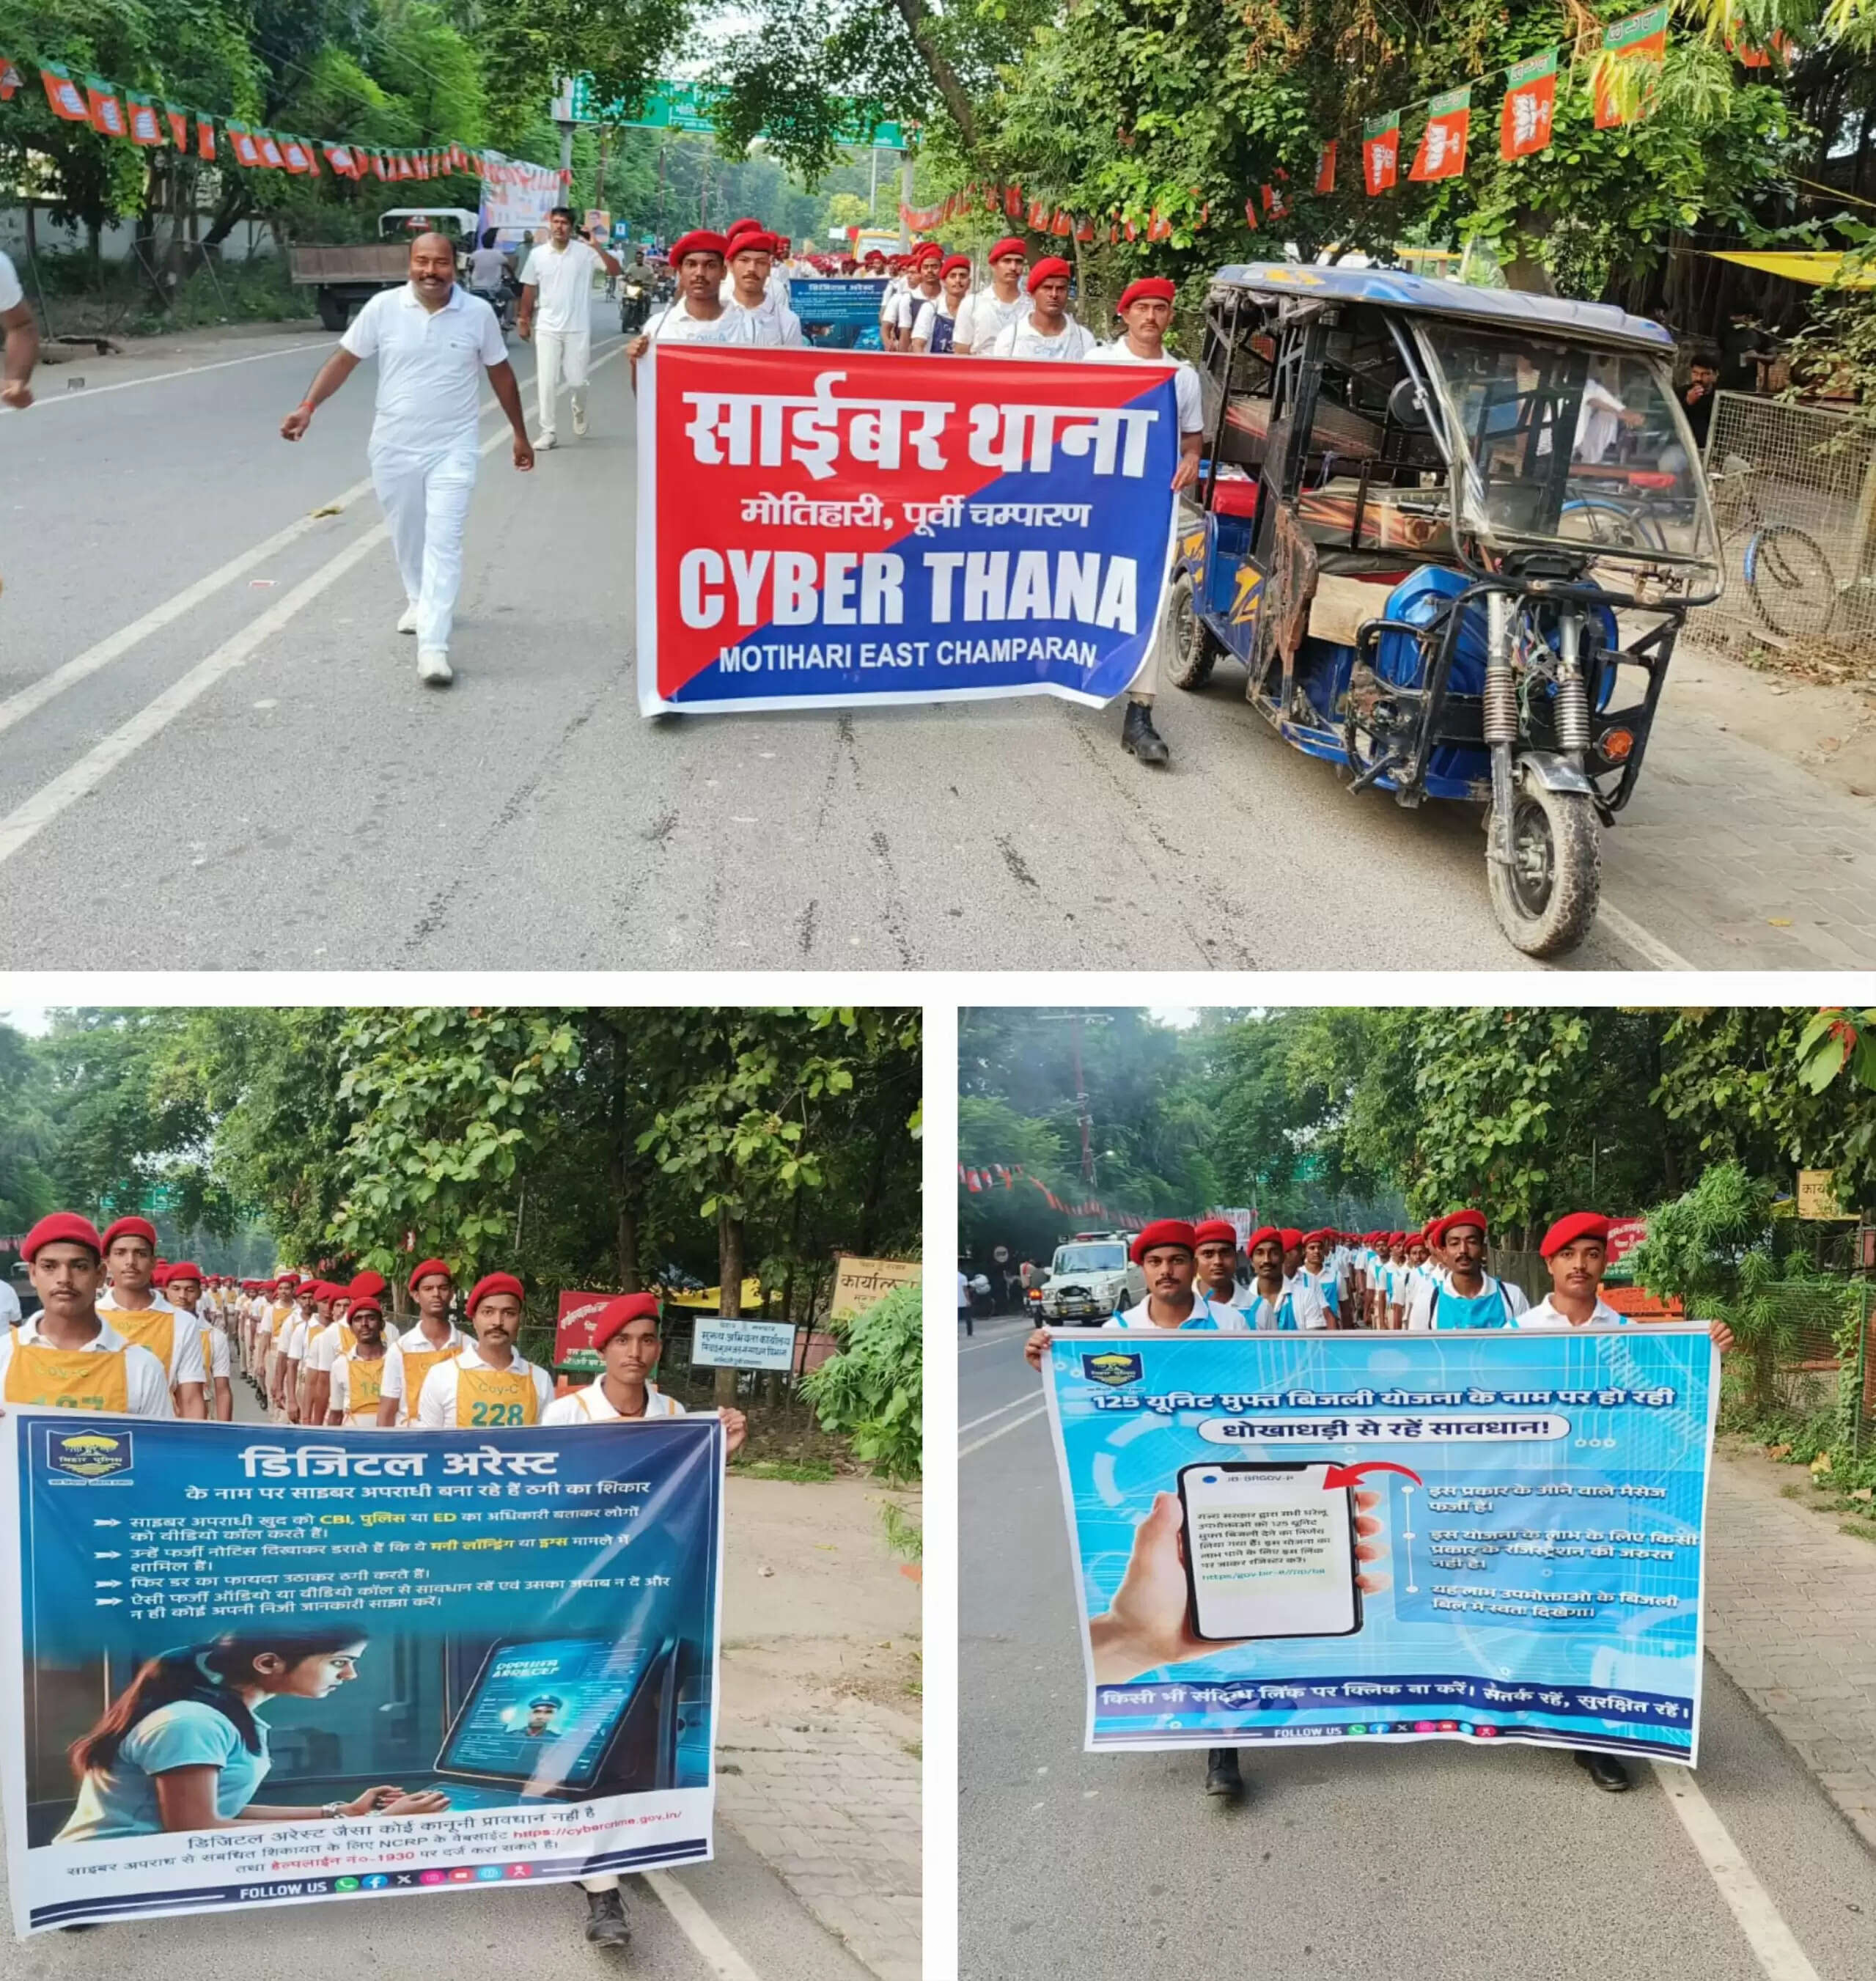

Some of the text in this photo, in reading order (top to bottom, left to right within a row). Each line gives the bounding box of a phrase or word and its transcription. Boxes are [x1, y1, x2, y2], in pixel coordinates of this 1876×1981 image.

[683, 371, 1158, 479] साईबर थाना
[741, 492, 1092, 537] मोतिहारी, पूर्वी चम्पारण
[679, 548, 1137, 635] CYBER THANA
[719, 637, 1096, 672] MOTIHARI EAST CHAMPARAN
[841, 1272, 919, 1290] कार्याल
[1093, 1387, 1674, 1413] 125 यूनिट मुफ्त बिजली योजना के नाम पर हो रही
[472, 1401, 523, 1427] 228
[1223, 1419, 1549, 1442] धोखाधड़ी से रहें सावधान!
[238, 1445, 559, 1478] डिजिटल अरेस्ट
[185, 1485, 207, 1501] के
[215, 1489, 252, 1500] नाम
[260, 1488, 284, 1499] पर
[291, 1488, 355, 1501] साइबर
[363, 1482, 431, 1498] अपराधी
[439, 1485, 472, 1497] बना
[479, 1482, 501, 1498] रहे
[527, 1482, 559, 1496] ठगी
[566, 1483, 590, 1495] का
[597, 1480, 650, 1495] शिकार
[1429, 1486, 1457, 1499] इस
[1461, 1486, 1509, 1499] प्रकार
[1512, 1485, 1531, 1497] के
[1538, 1485, 1572, 1498] आने
[1578, 1485, 1614, 1498] वाले
[129, 1508, 600, 1529] साइबर अपराधी खुद को पुलिस या ED का अधिकारी बताकर
[130, 1526, 305, 1543] को वीडियो कॉल करते
[1429, 1529, 1699, 1547] इस योजना लाभ लिए किसी
[164, 1546, 203, 1558] फर्जी
[208, 1545, 256, 1558] नोटिस
[262, 1543, 326, 1556] दिखाकर
[430, 1539, 458, 1551] मनी
[1430, 1544, 1476, 1556] प्रकार
[130, 1559, 188, 1573] शामिल
[130, 1568, 409, 1589] फिर डर का फायदा उठाकर ठगी करते
[131, 1576, 670, 1606] ऐसी फर्जी ऑडियो वीडियो कॉल सावधान उसका और
[1460, 1585, 1679, 1609] लाभ बिजली
[172, 1598, 407, 1617] कोई अपनी निजी जानकारी साझा
[1433, 1598, 1466, 1611] बिल
[1101, 1690, 1156, 1706] किसी
[1160, 1688, 1185, 1703] भी
[1258, 1685, 1305, 1700] लिंक
[1312, 1687, 1336, 1698] पर
[1343, 1682, 1402, 1697] क्लिक
[1577, 1694, 1649, 1714] सुरक्षित
[1274, 1726, 1342, 1738] FOLLOW US
[188, 1812, 545, 1850] डिजिटल अरेस्ट जैसा कोई कानूनी प्रावधान
[67, 1810, 682, 1876] साइबर अपराध शिकायत NCRP https://cybercrime.gov.in/
[235, 1863, 265, 1873] तथा
[504, 1842, 538, 1854] सकते
[240, 1882, 327, 1900] FOLLOW US
